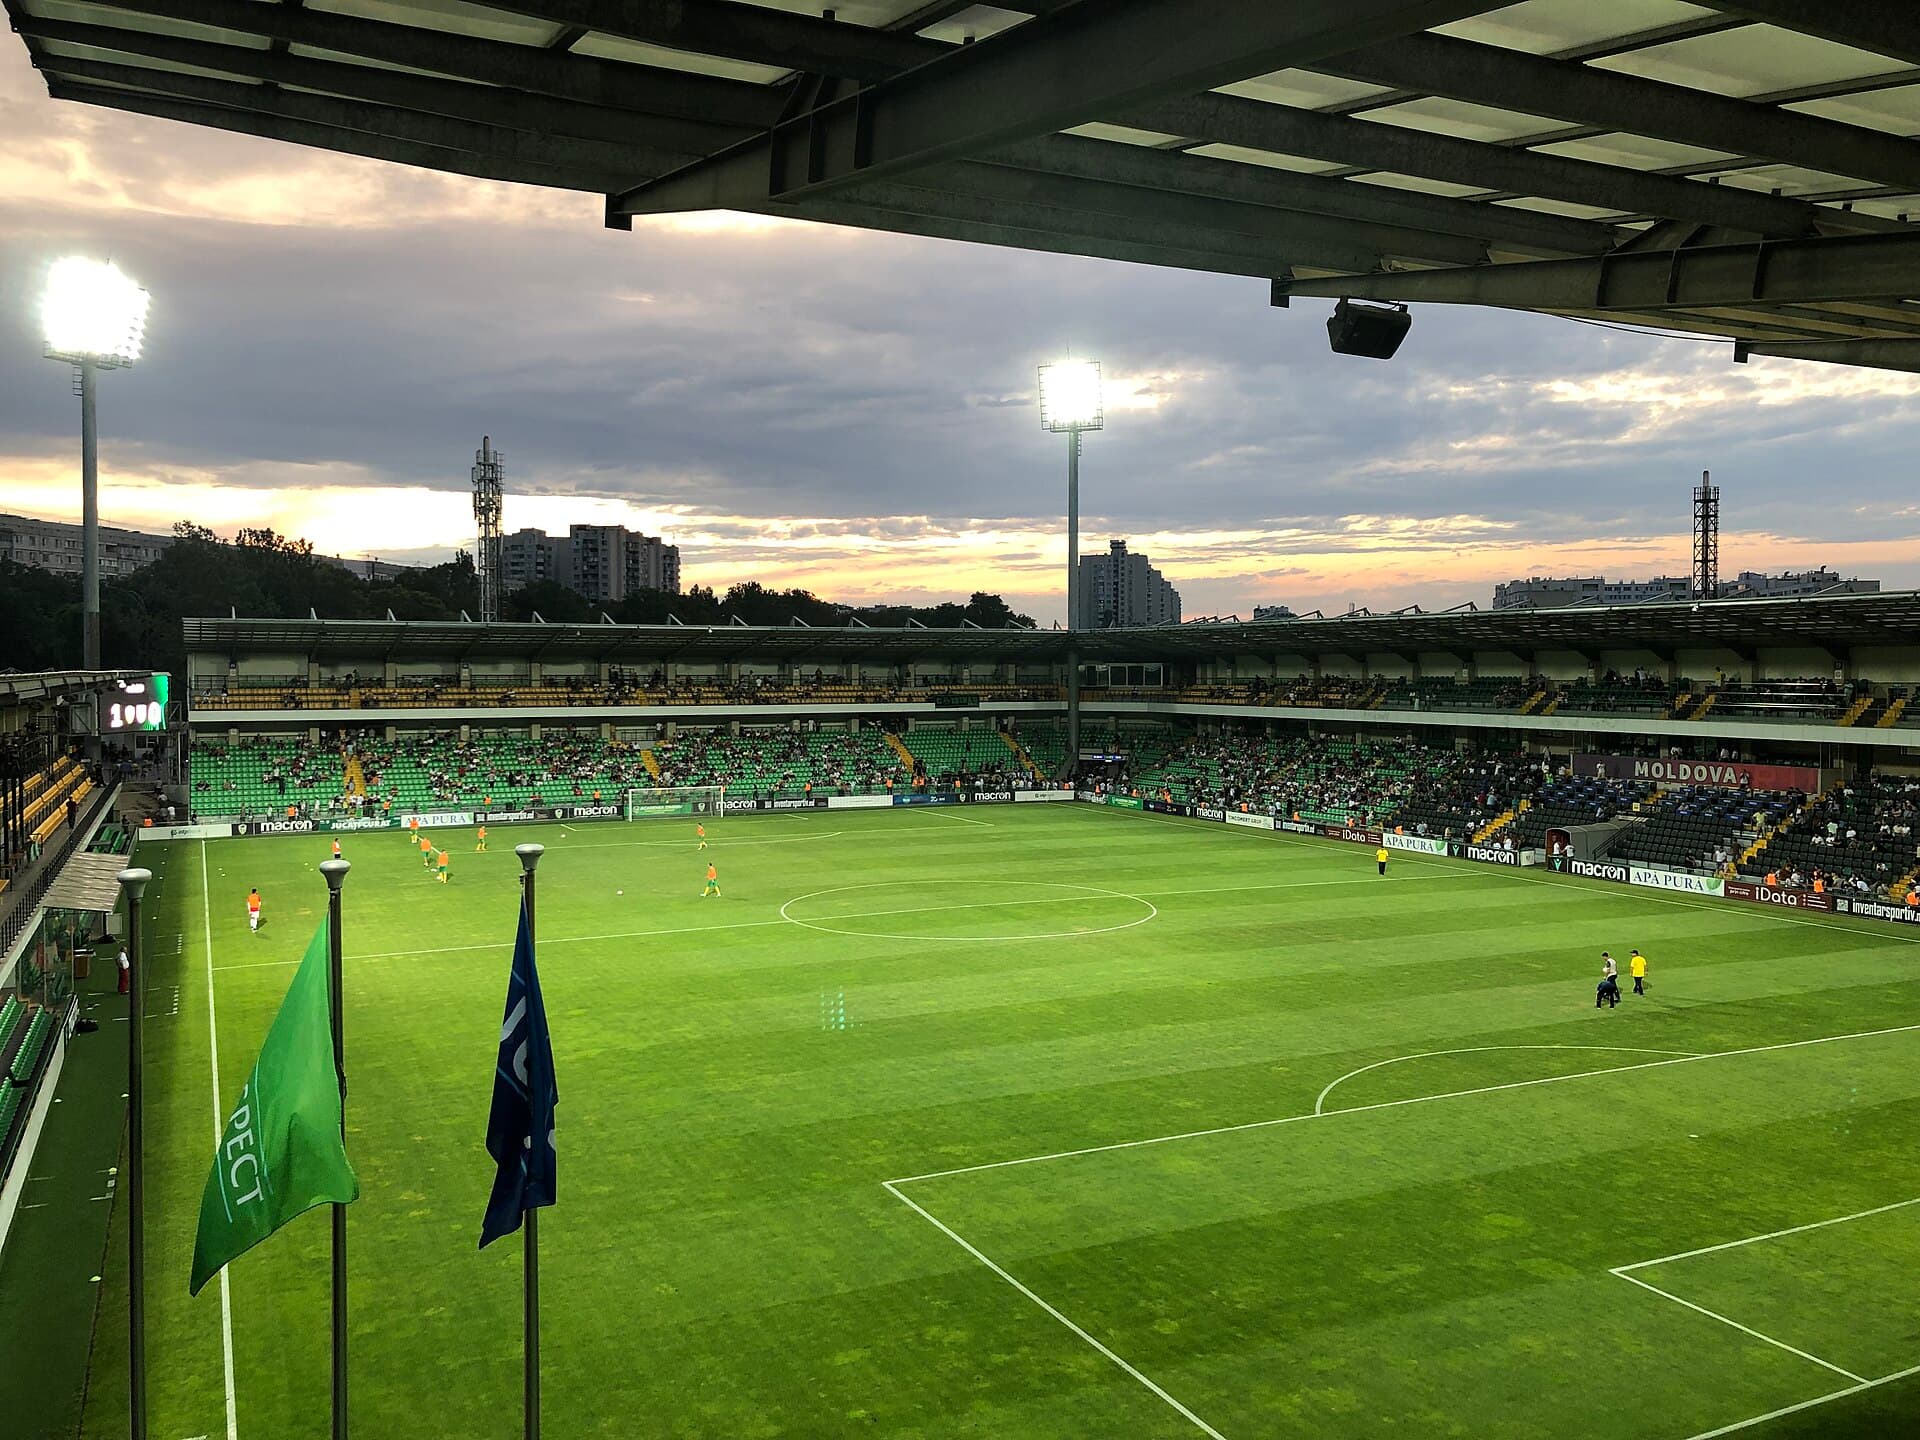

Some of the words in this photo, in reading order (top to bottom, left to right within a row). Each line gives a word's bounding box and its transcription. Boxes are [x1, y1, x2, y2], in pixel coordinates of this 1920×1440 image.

[1634, 761, 1737, 784] MOLDOVA
[975, 791, 1011, 801] macron
[573, 805, 618, 816] macron
[716, 799, 757, 810] macron
[1196, 807, 1224, 819] macron
[260, 819, 313, 832] macron
[1467, 846, 1515, 865] macron
[1571, 860, 1626, 881] macron
[226, 1084, 265, 1206] PECT
